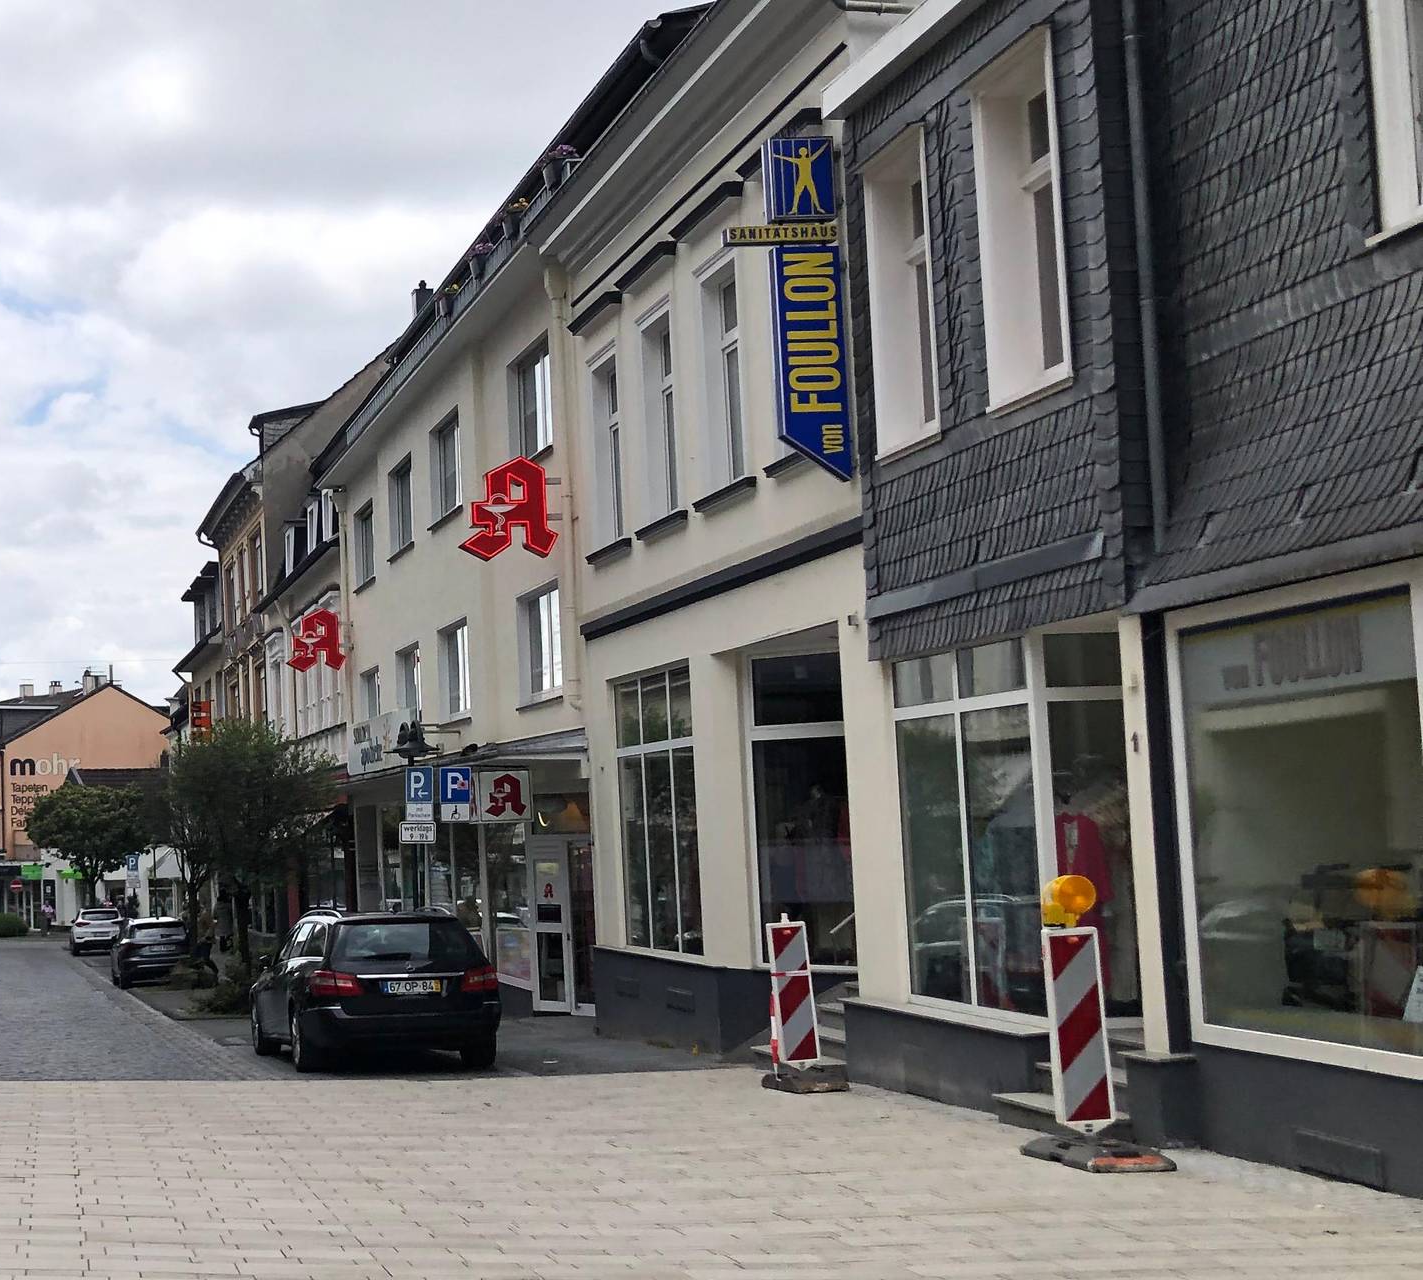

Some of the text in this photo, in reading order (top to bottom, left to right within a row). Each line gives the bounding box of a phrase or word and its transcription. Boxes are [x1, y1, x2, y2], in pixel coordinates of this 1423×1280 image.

[783, 252, 844, 454] von FOULLON
[10, 752, 81, 776] mohr
[11, 782, 48, 793] Tapeten
[410, 771, 425, 799] P
[447, 772, 463, 799] P
[403, 825, 433, 833] werktags
